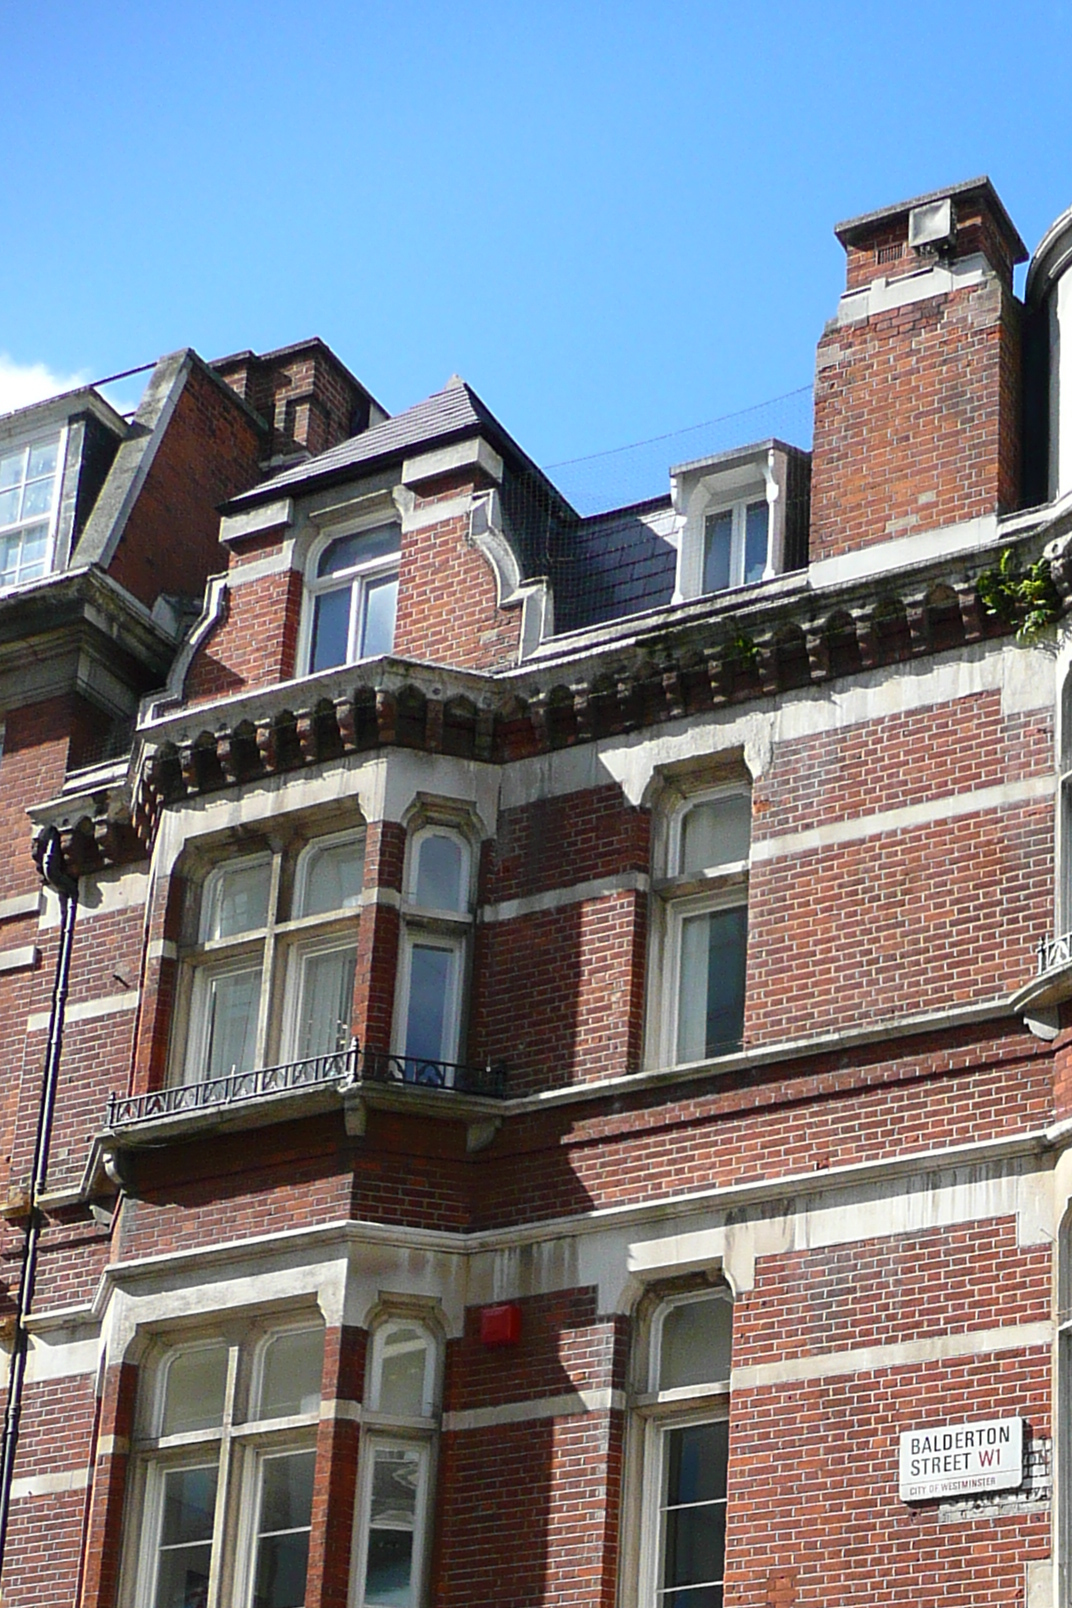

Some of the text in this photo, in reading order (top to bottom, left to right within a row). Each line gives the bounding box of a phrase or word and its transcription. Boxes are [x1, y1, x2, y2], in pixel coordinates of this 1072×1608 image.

[911, 1425, 1010, 1455] BALDERTON
[911, 1448, 1001, 1477] STREET W1
[910, 1476, 996, 1496] CITY OF WESTMINSTER
